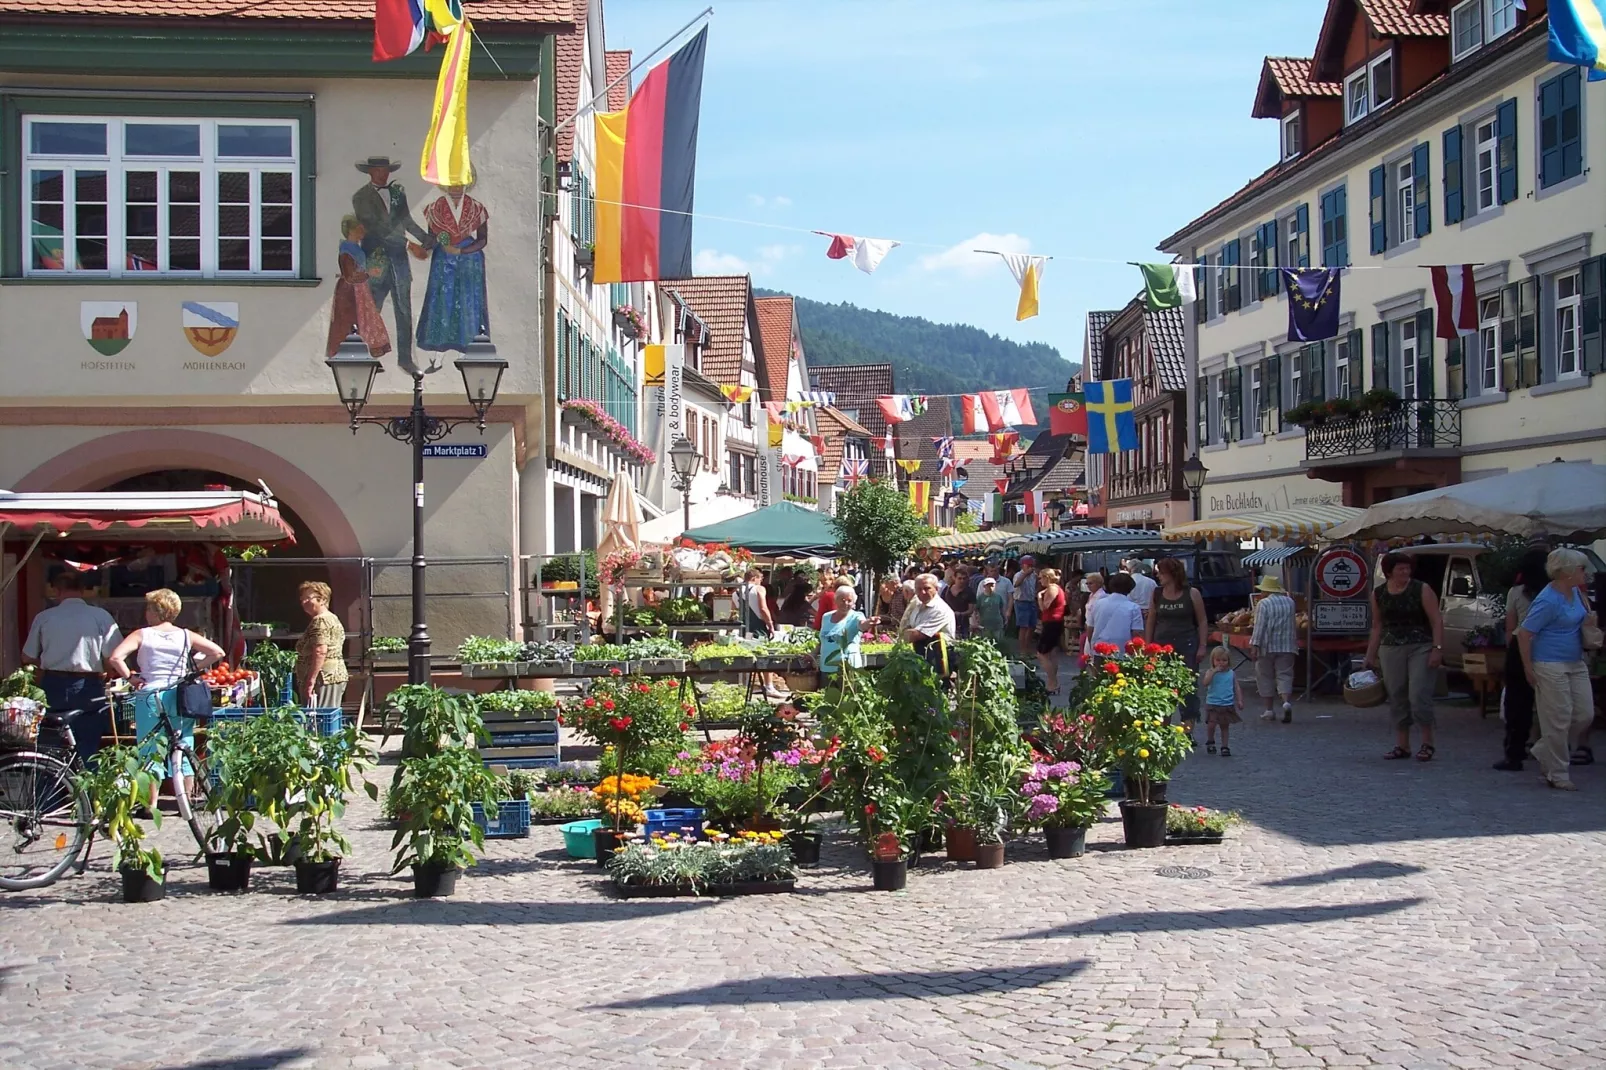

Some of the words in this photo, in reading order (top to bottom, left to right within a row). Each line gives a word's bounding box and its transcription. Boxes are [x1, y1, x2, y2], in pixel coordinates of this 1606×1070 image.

[80, 361, 136, 370] HOFSTETTEN
[669, 365, 681, 417] bodywear
[669, 422, 679, 430] &
[434, 446, 476, 457] Marktplatz
[479, 446, 482, 455] 1
[760, 455, 769, 506] trendhouse
